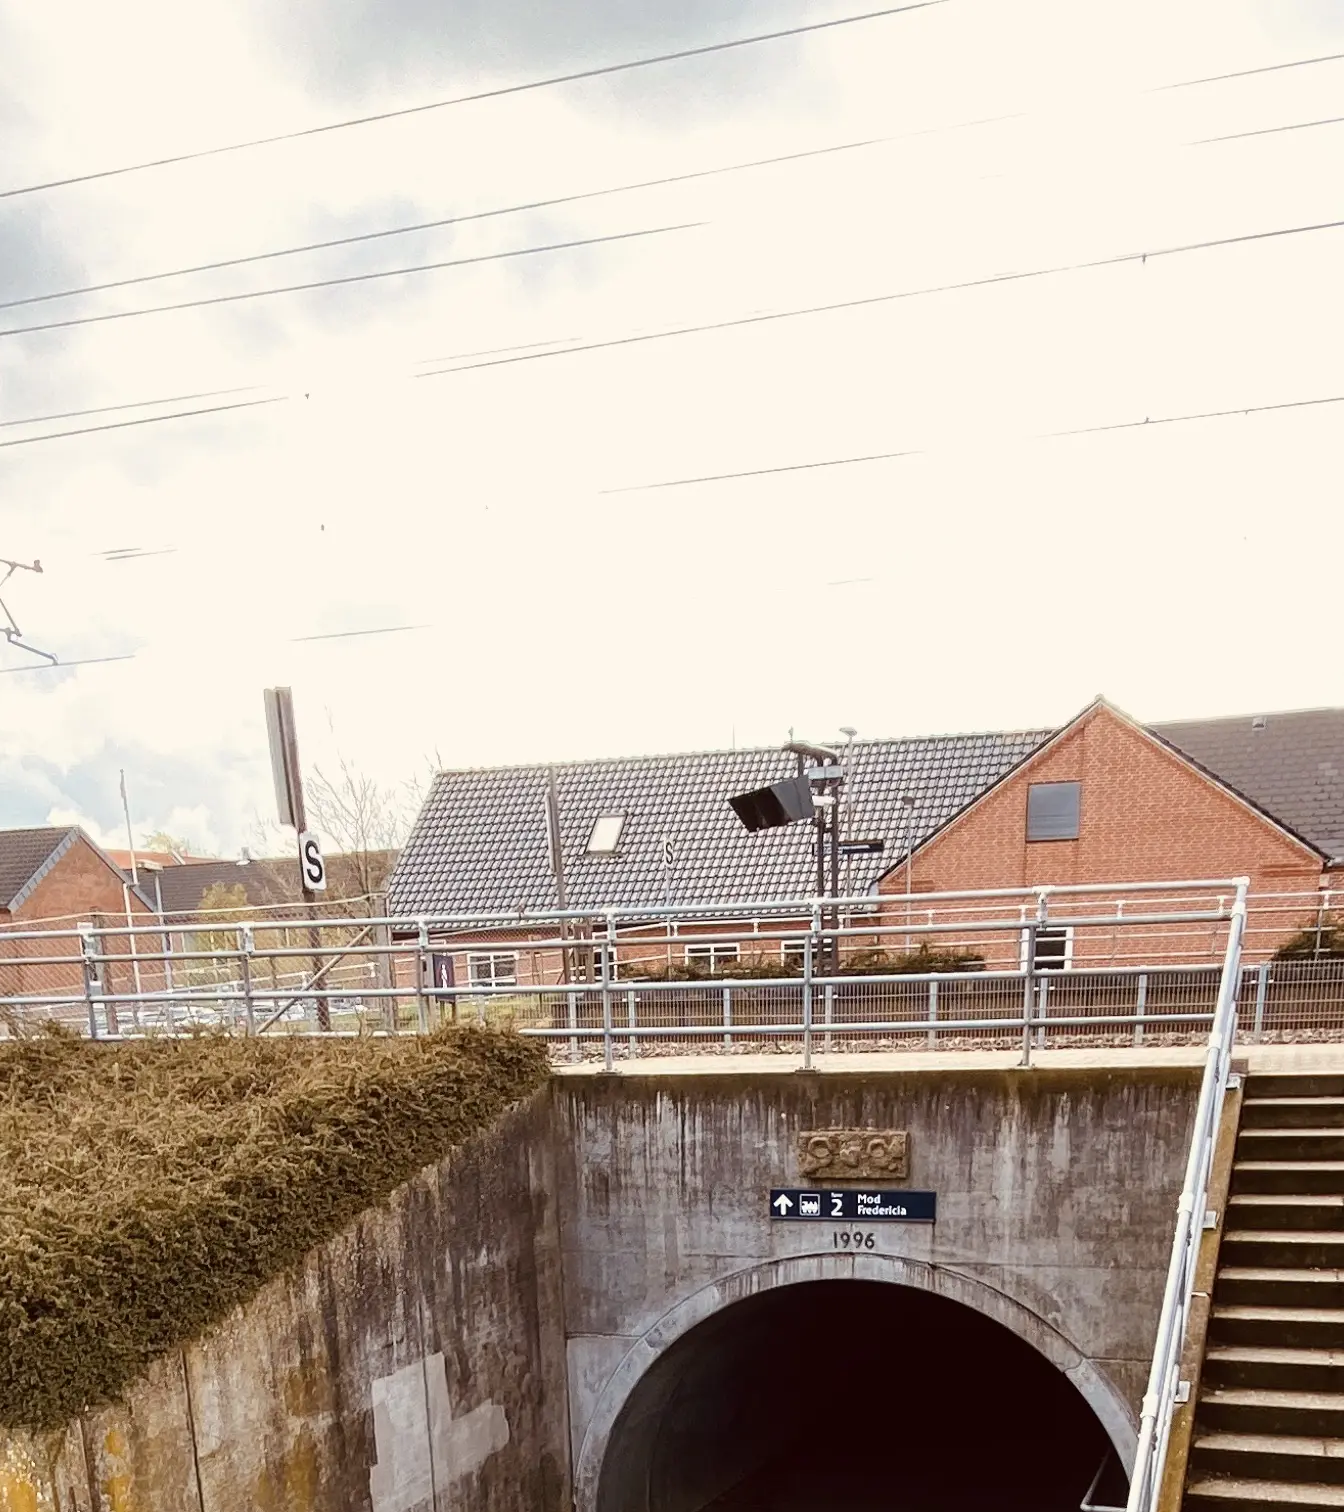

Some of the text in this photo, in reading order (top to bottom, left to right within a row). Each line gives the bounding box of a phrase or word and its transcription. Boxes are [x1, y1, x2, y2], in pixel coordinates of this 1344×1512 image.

[305, 840, 323, 883] S
[666, 842, 674, 865] S
[830, 1199, 844, 1217] 2
[857, 1194, 881, 1204] Mod
[857, 1205, 907, 1216] Fredericia
[833, 1231, 875, 1250] 1996
